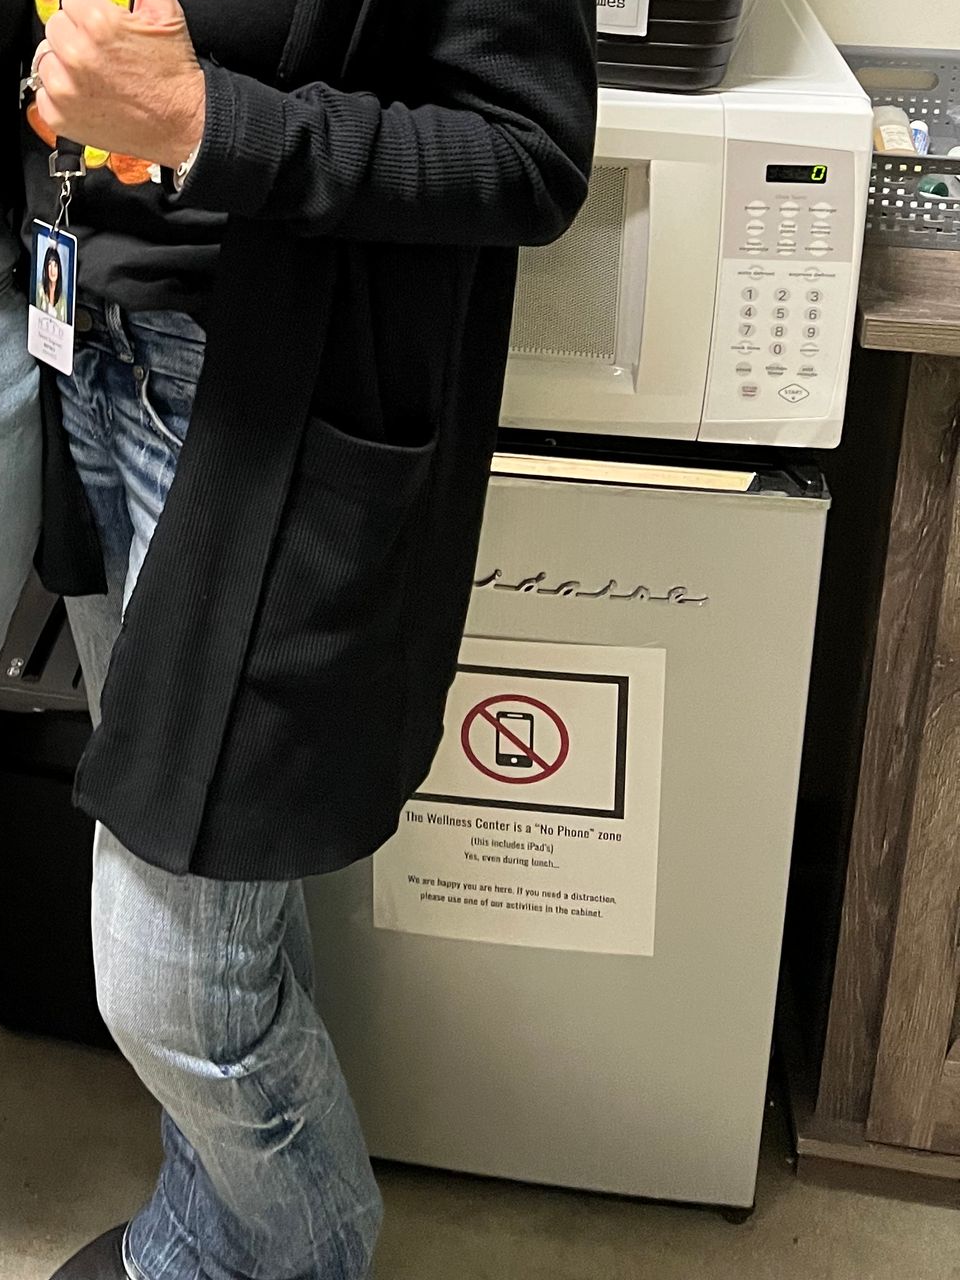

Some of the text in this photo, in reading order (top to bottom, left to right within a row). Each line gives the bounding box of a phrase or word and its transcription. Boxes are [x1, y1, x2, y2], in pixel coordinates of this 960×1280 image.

[811, 165, 826, 181] 0
[746, 289, 819, 302] 1 2 3
[744, 307, 817, 320] 4 5 6
[744, 325, 816, 337] 7 8 9
[773, 344, 782, 355] 0
[406, 811, 424, 823] The
[427, 813, 472, 828] Wellness
[475, 818, 509, 831] Center
[513, 821, 522, 833] is
[525, 825, 531, 833] a
[597, 832, 622, 842] zone
[470, 837, 490, 847] (this
[491, 840, 525, 851] includes
[482, 855, 501, 863] even
[503, 856, 529, 867] during
[408, 875, 420, 884] We
[437, 878, 460, 890] happy
[463, 882, 477, 891] you
[525, 889, 539, 898] you
[542, 890, 561, 899] need
[420, 892, 445, 903] please
[506, 902, 543, 912] activities
[555, 905, 568, 915] the
